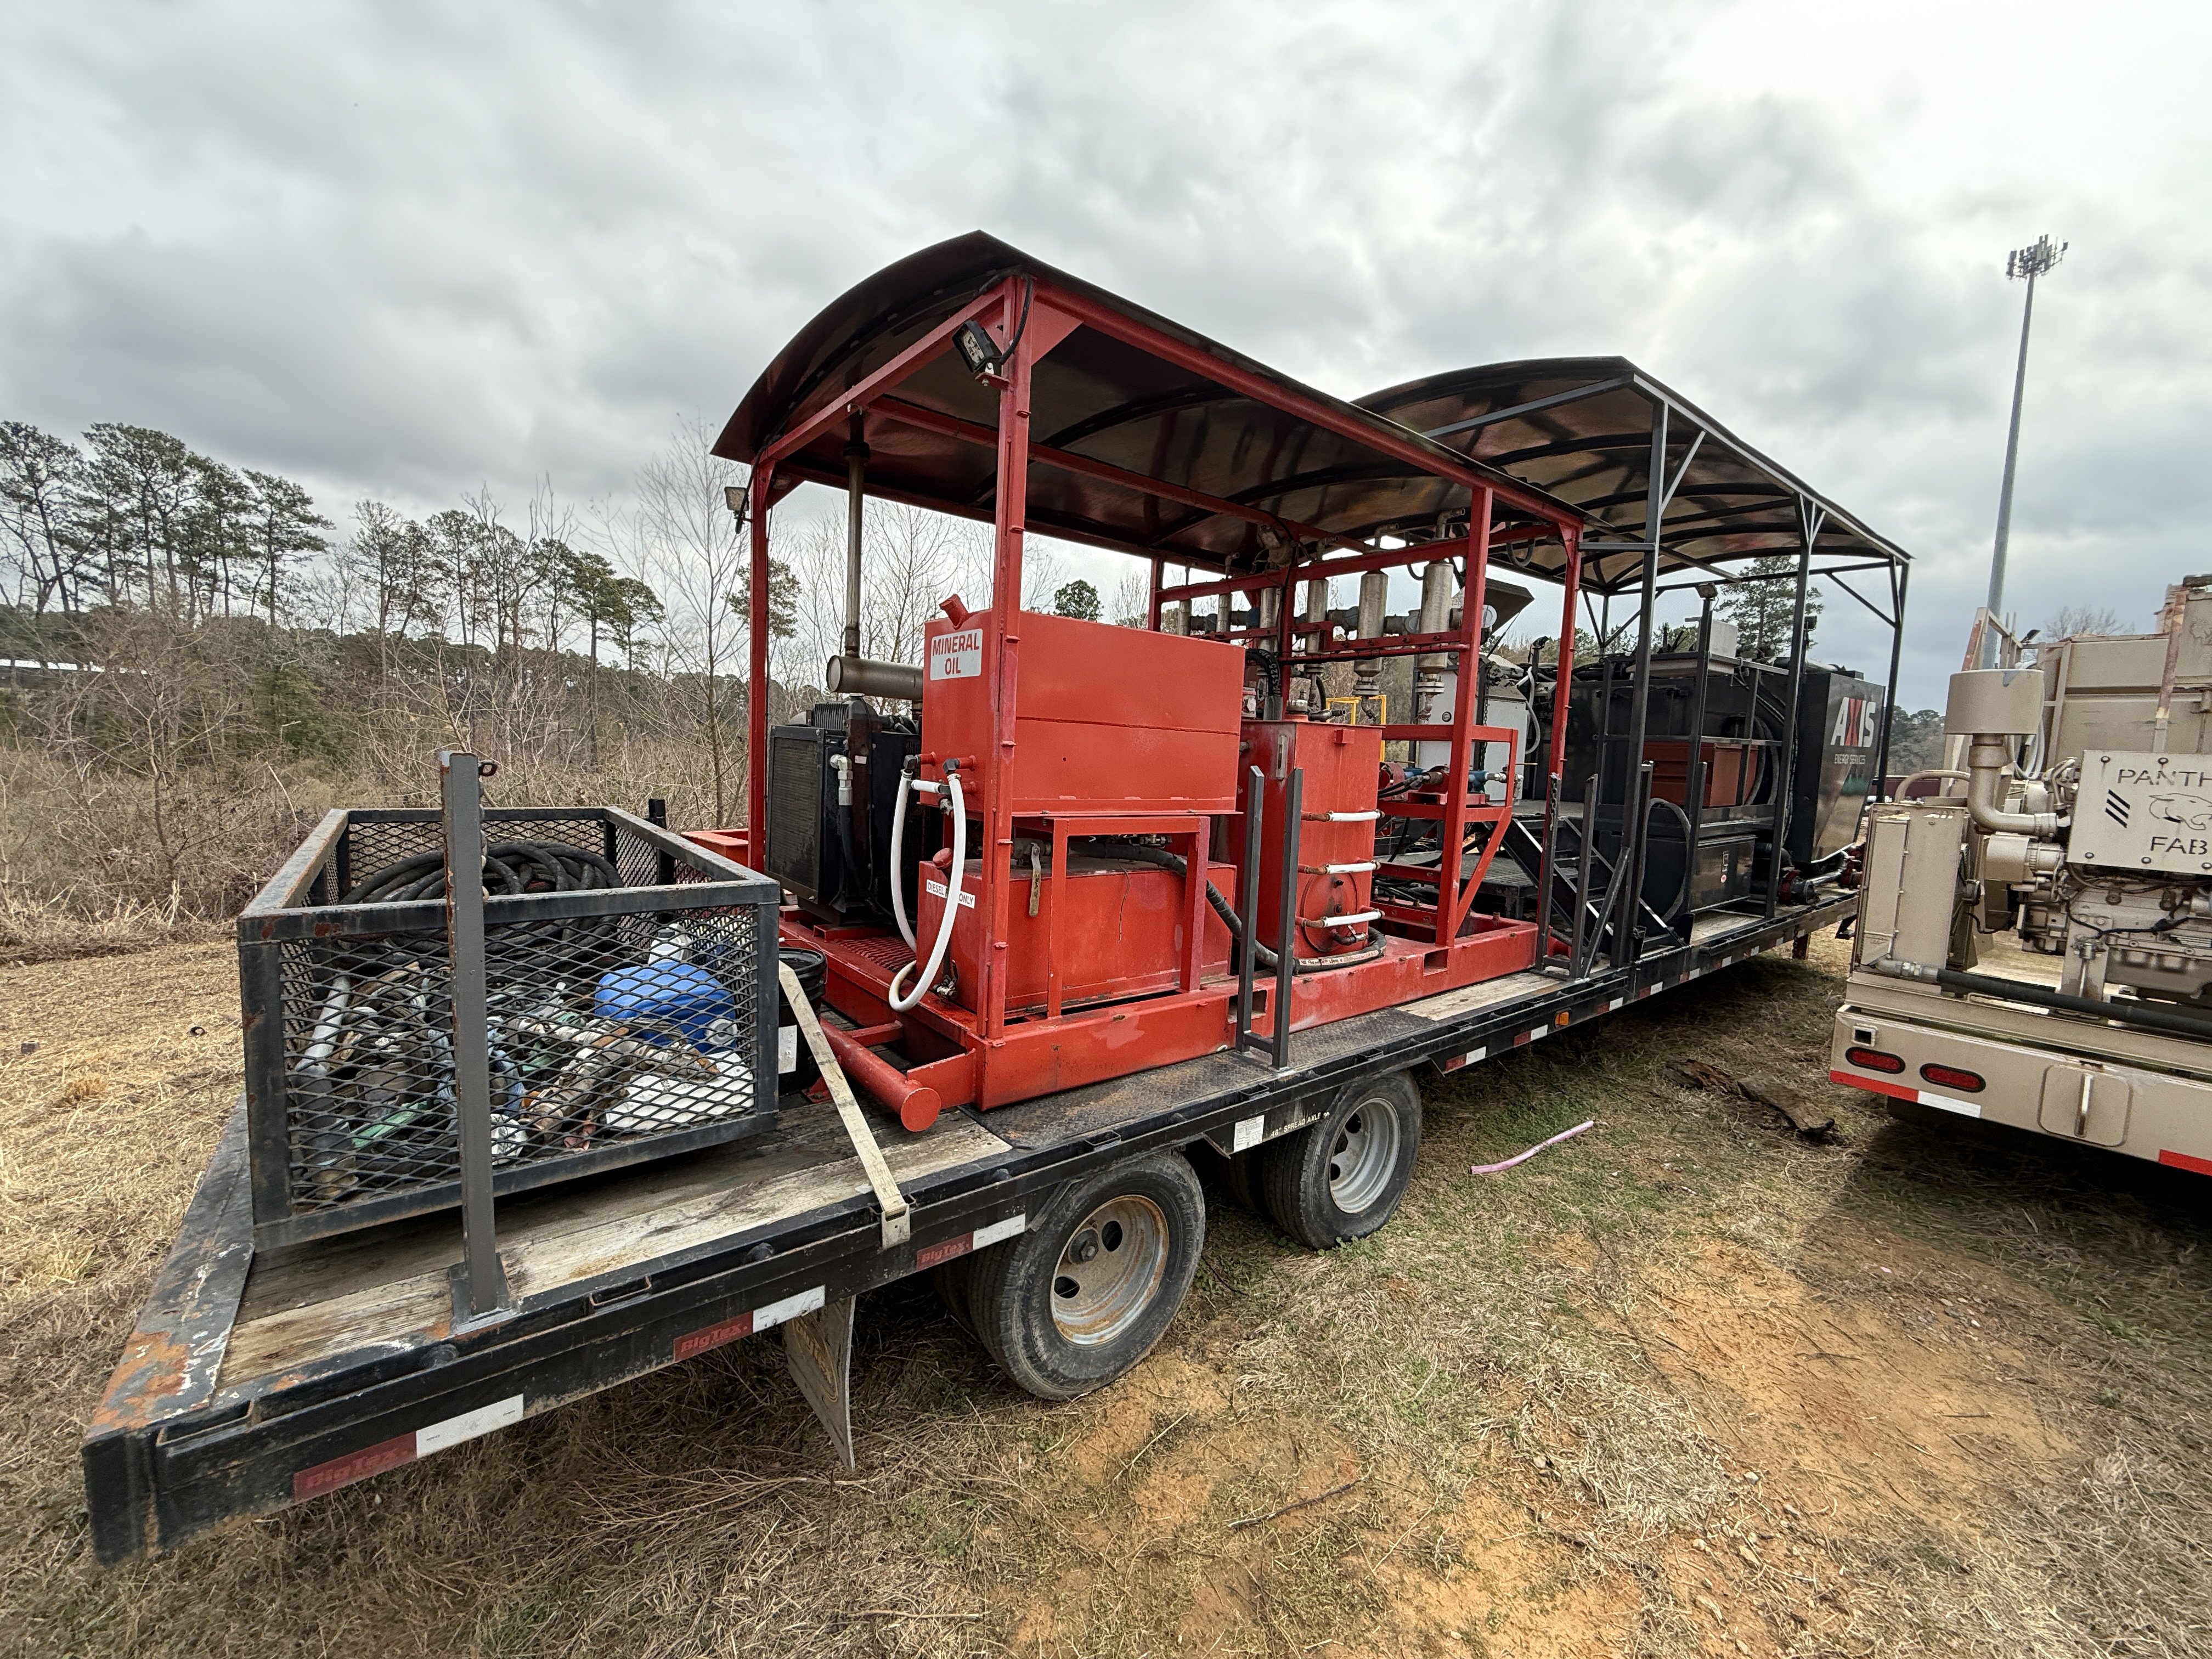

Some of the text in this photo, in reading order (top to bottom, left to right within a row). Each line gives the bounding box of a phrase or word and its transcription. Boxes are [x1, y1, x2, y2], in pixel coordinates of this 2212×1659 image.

[933, 633, 979, 656] MINERAL
[945, 657, 961, 675] OIL
[1830, 697, 1876, 747] AXIS
[2117, 769, 2212, 787] PANTH
[2150, 836, 2208, 855] FAB
[928, 882, 944, 895] DIESEL
[958, 893, 974, 905] ONLY
[1271, 1127, 1282, 1137] 48"
[1284, 1118, 1305, 1132] SPREAD
[1307, 1112, 1321, 1124] AXLE
